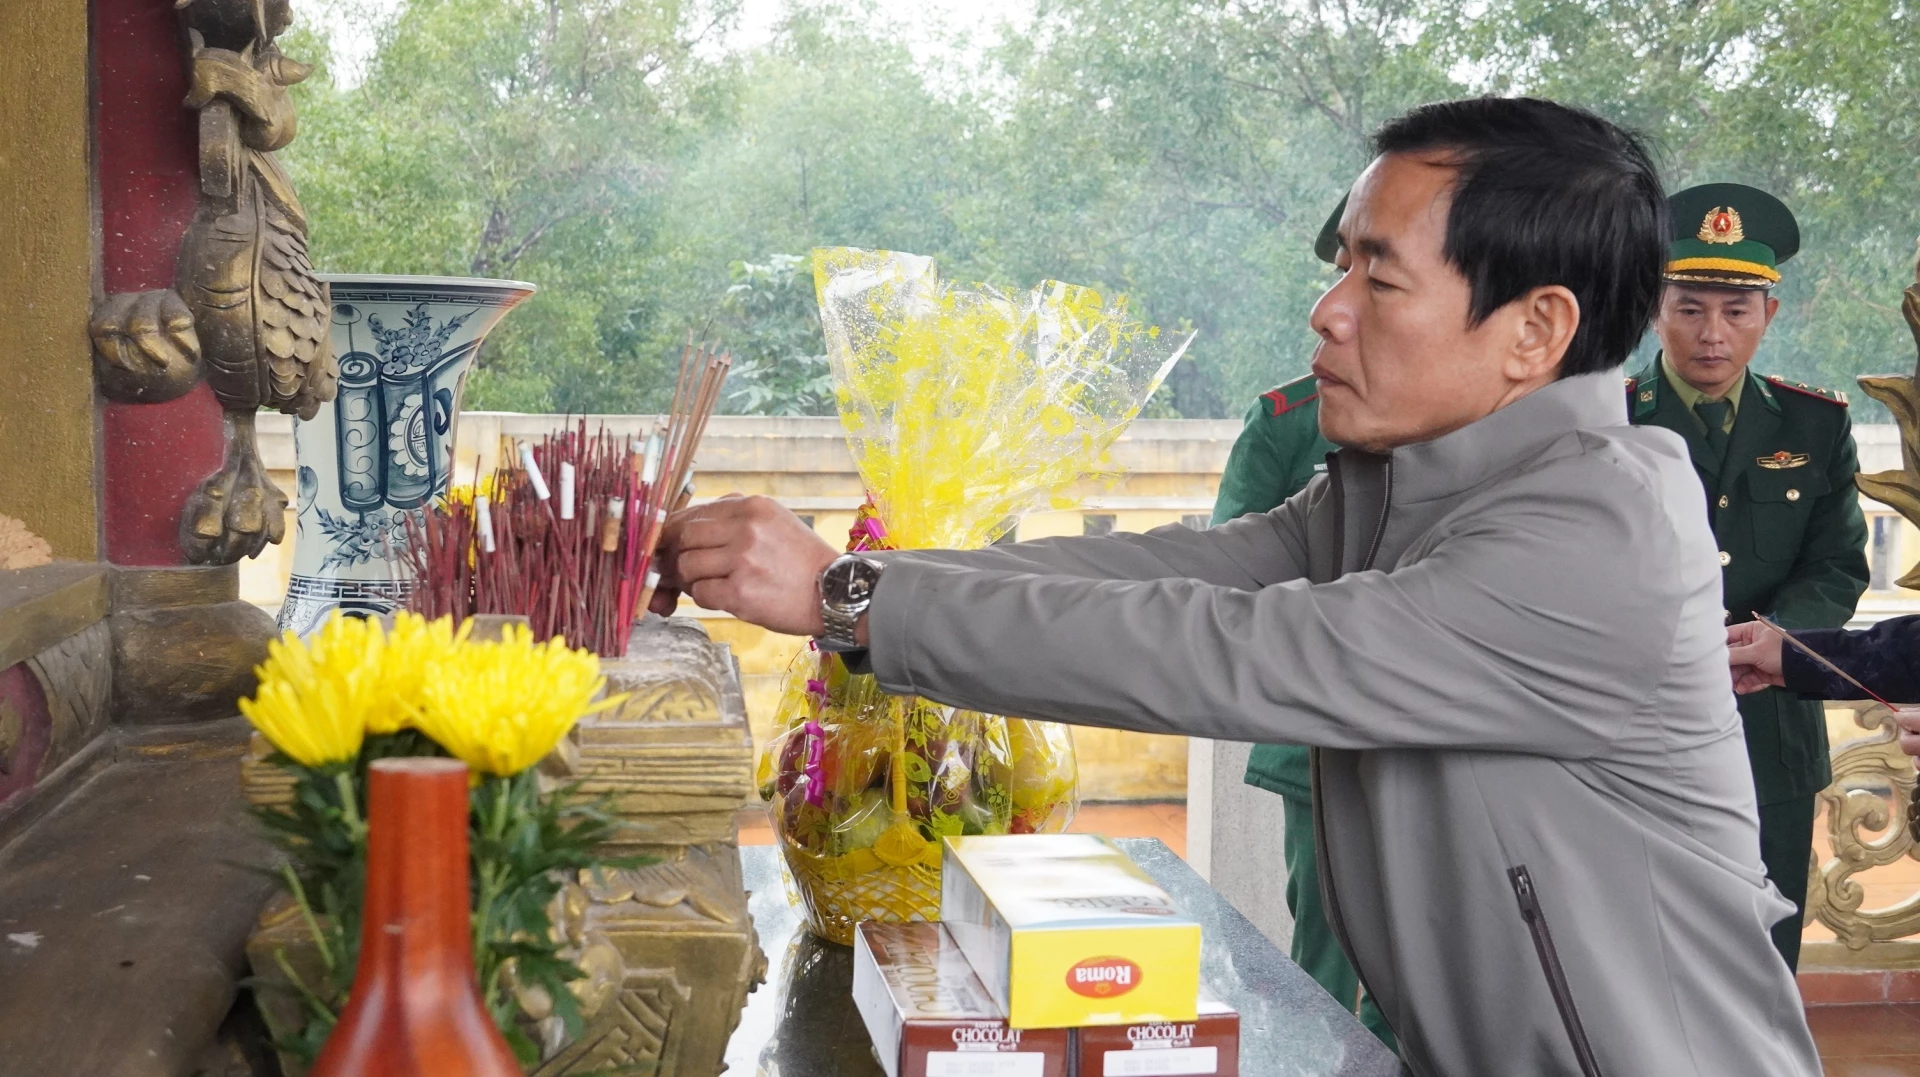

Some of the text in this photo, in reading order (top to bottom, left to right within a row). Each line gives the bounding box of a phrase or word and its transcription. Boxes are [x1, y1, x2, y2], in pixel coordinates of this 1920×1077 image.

[1075, 965, 1131, 985] Roma
[951, 1027, 1023, 1043] CHOCOLAT
[1126, 1024, 1196, 1041] CHOCOLAT
